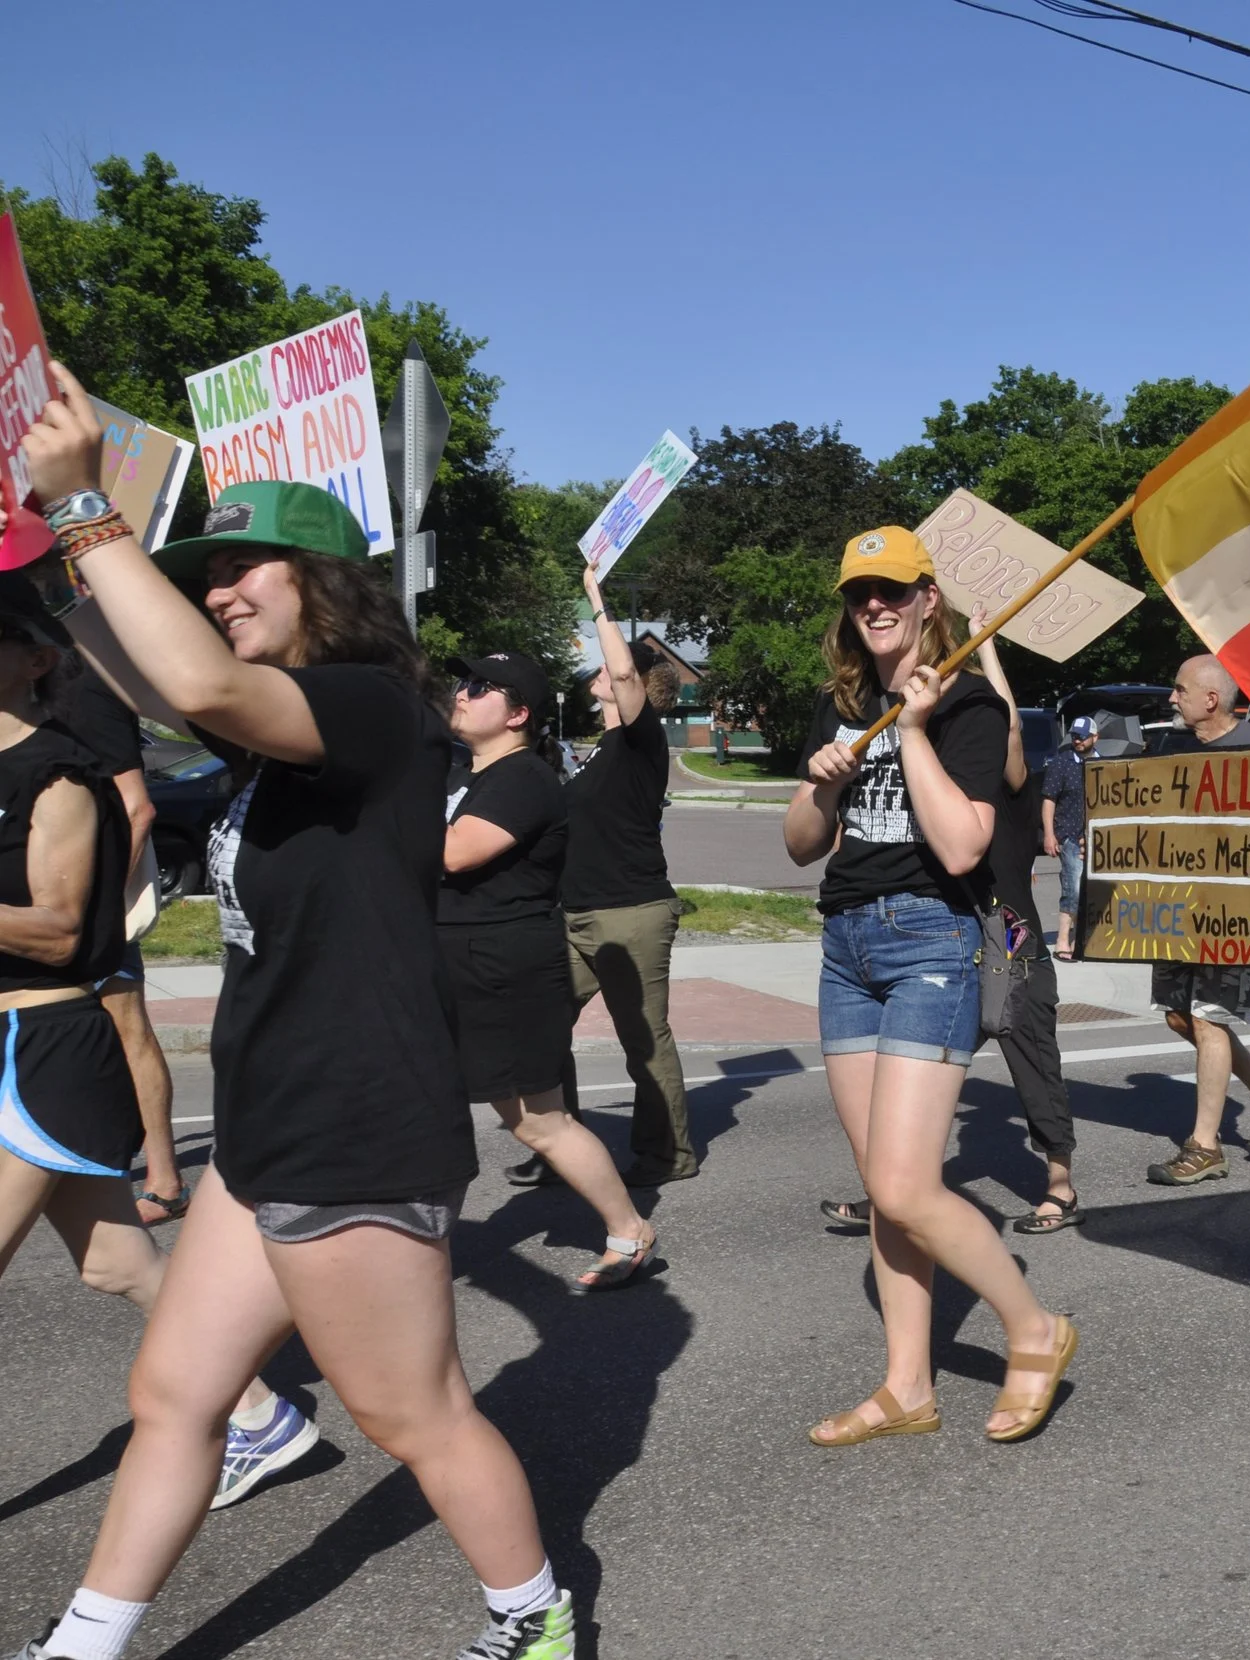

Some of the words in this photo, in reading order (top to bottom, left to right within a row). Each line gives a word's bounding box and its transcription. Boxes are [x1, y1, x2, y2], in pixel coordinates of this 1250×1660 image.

[188, 354, 269, 433] WAARC
[270, 316, 366, 410] CONDEMNS
[203, 415, 293, 507] RACISM
[302, 393, 366, 478] AND
[1086, 764, 1162, 810] Justice
[1171, 765, 1190, 809] 4
[1157, 830, 1206, 872] Lives
[1117, 898, 1185, 936] POLICE
